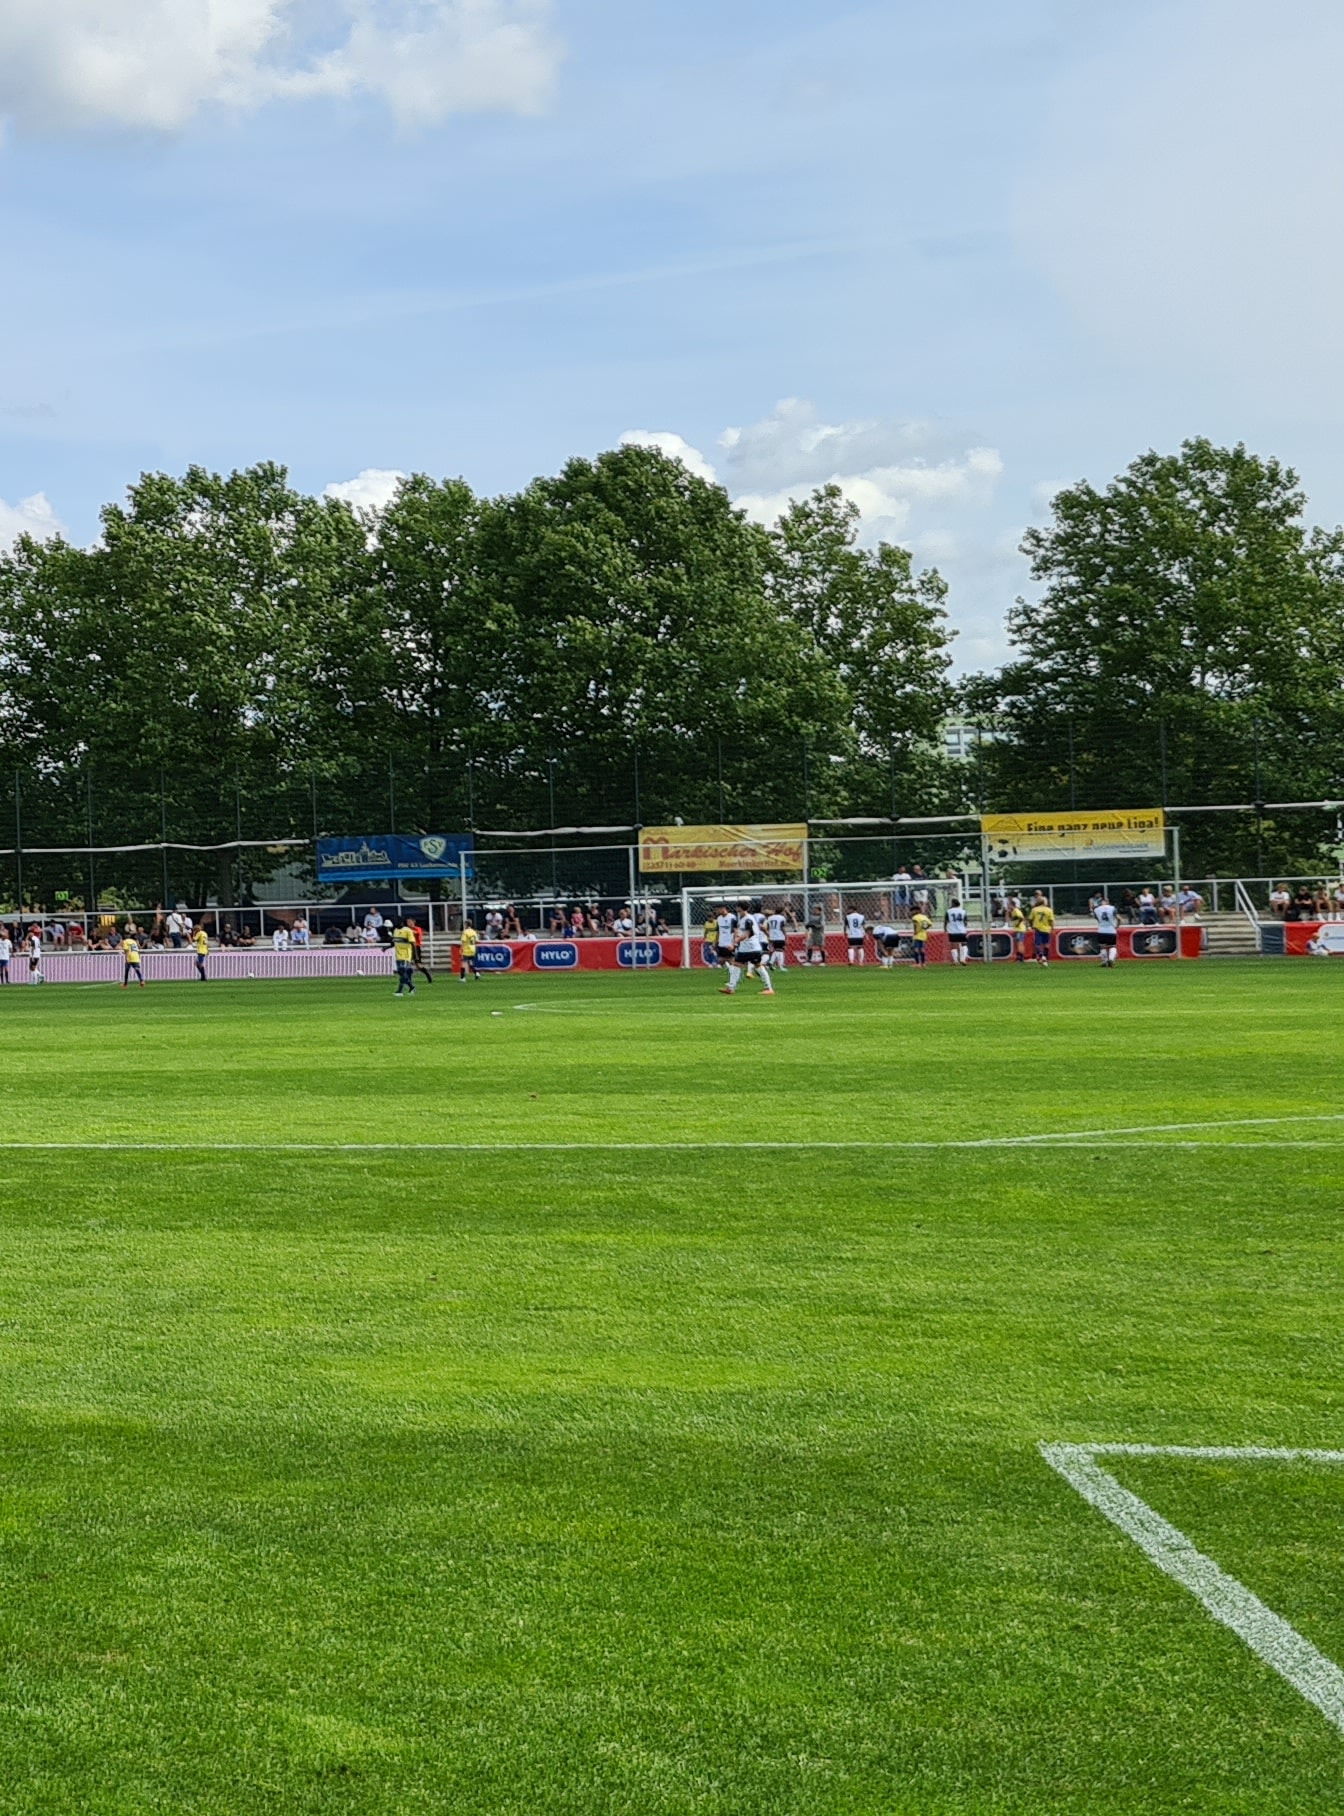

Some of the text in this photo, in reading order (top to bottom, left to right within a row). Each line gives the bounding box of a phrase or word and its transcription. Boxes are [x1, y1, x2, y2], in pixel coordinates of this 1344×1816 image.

[952, 913, 962, 922] 14
[1102, 911, 1109, 922] 4
[477, 952, 505, 962] HYLO
[541, 951, 570, 960] HYLO
